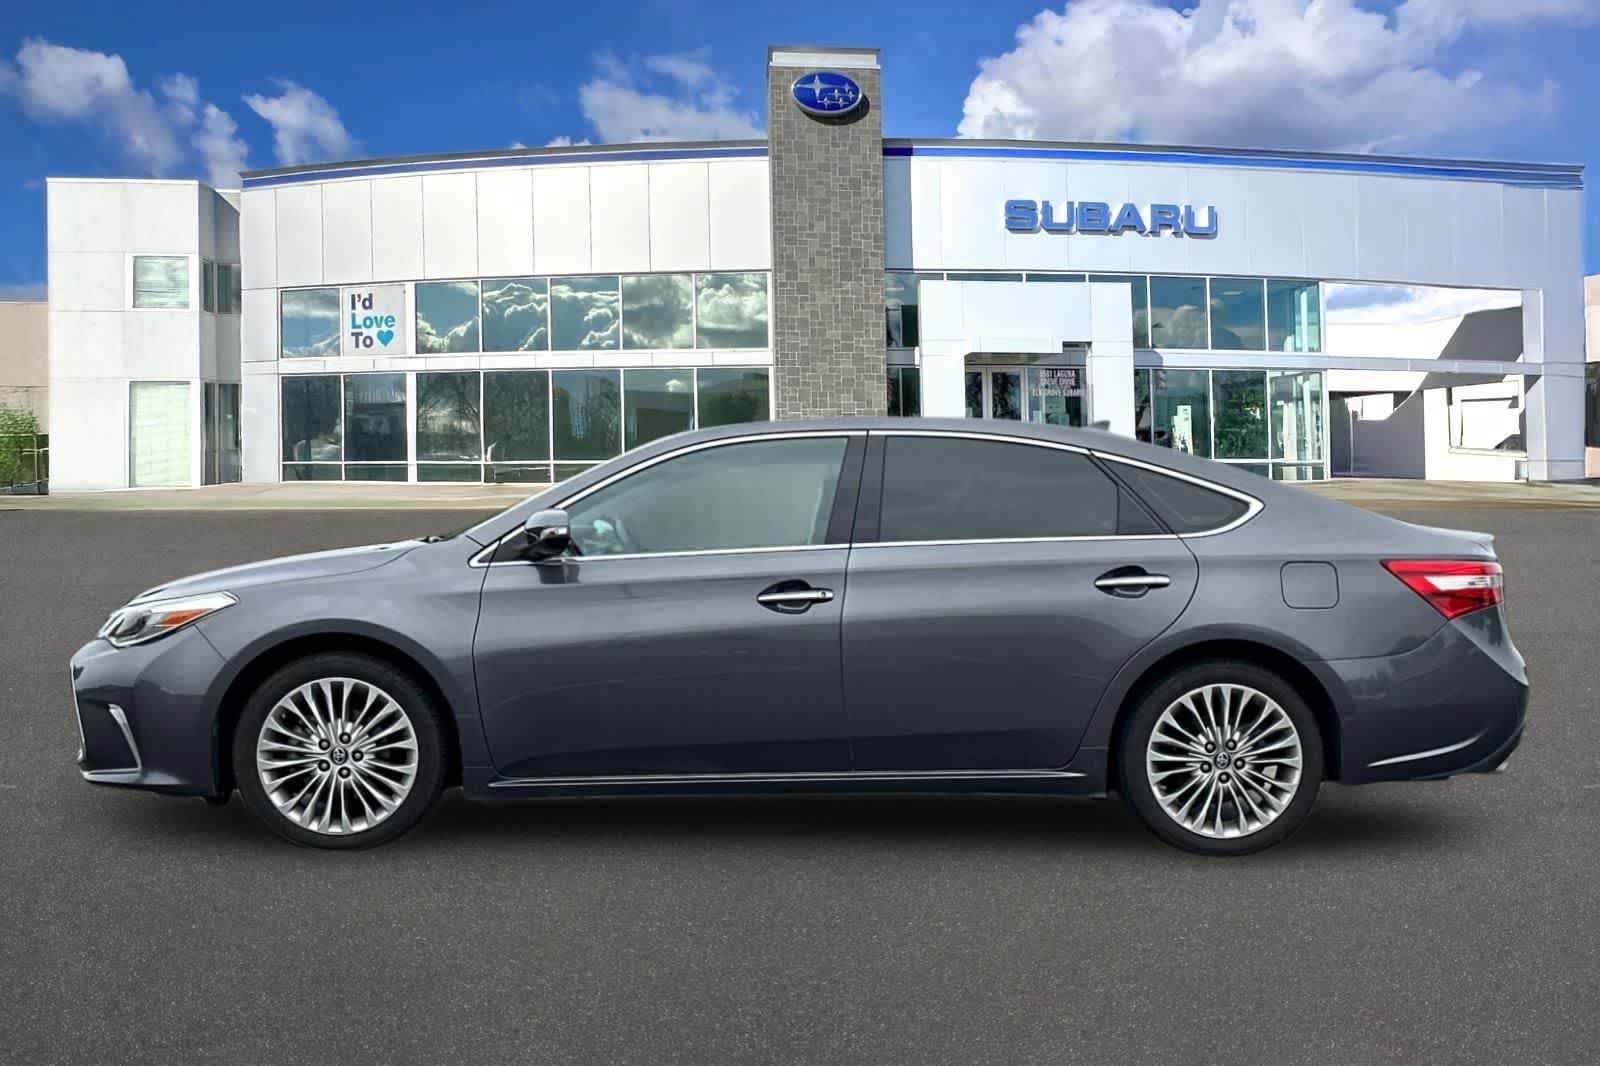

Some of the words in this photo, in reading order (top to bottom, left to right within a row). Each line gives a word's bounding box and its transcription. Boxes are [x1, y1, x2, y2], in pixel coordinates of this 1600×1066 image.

[1005, 200, 1217, 238] SUBARU
[351, 293, 373, 310] I'd
[351, 313, 395, 329] Love
[351, 332, 374, 348] To
